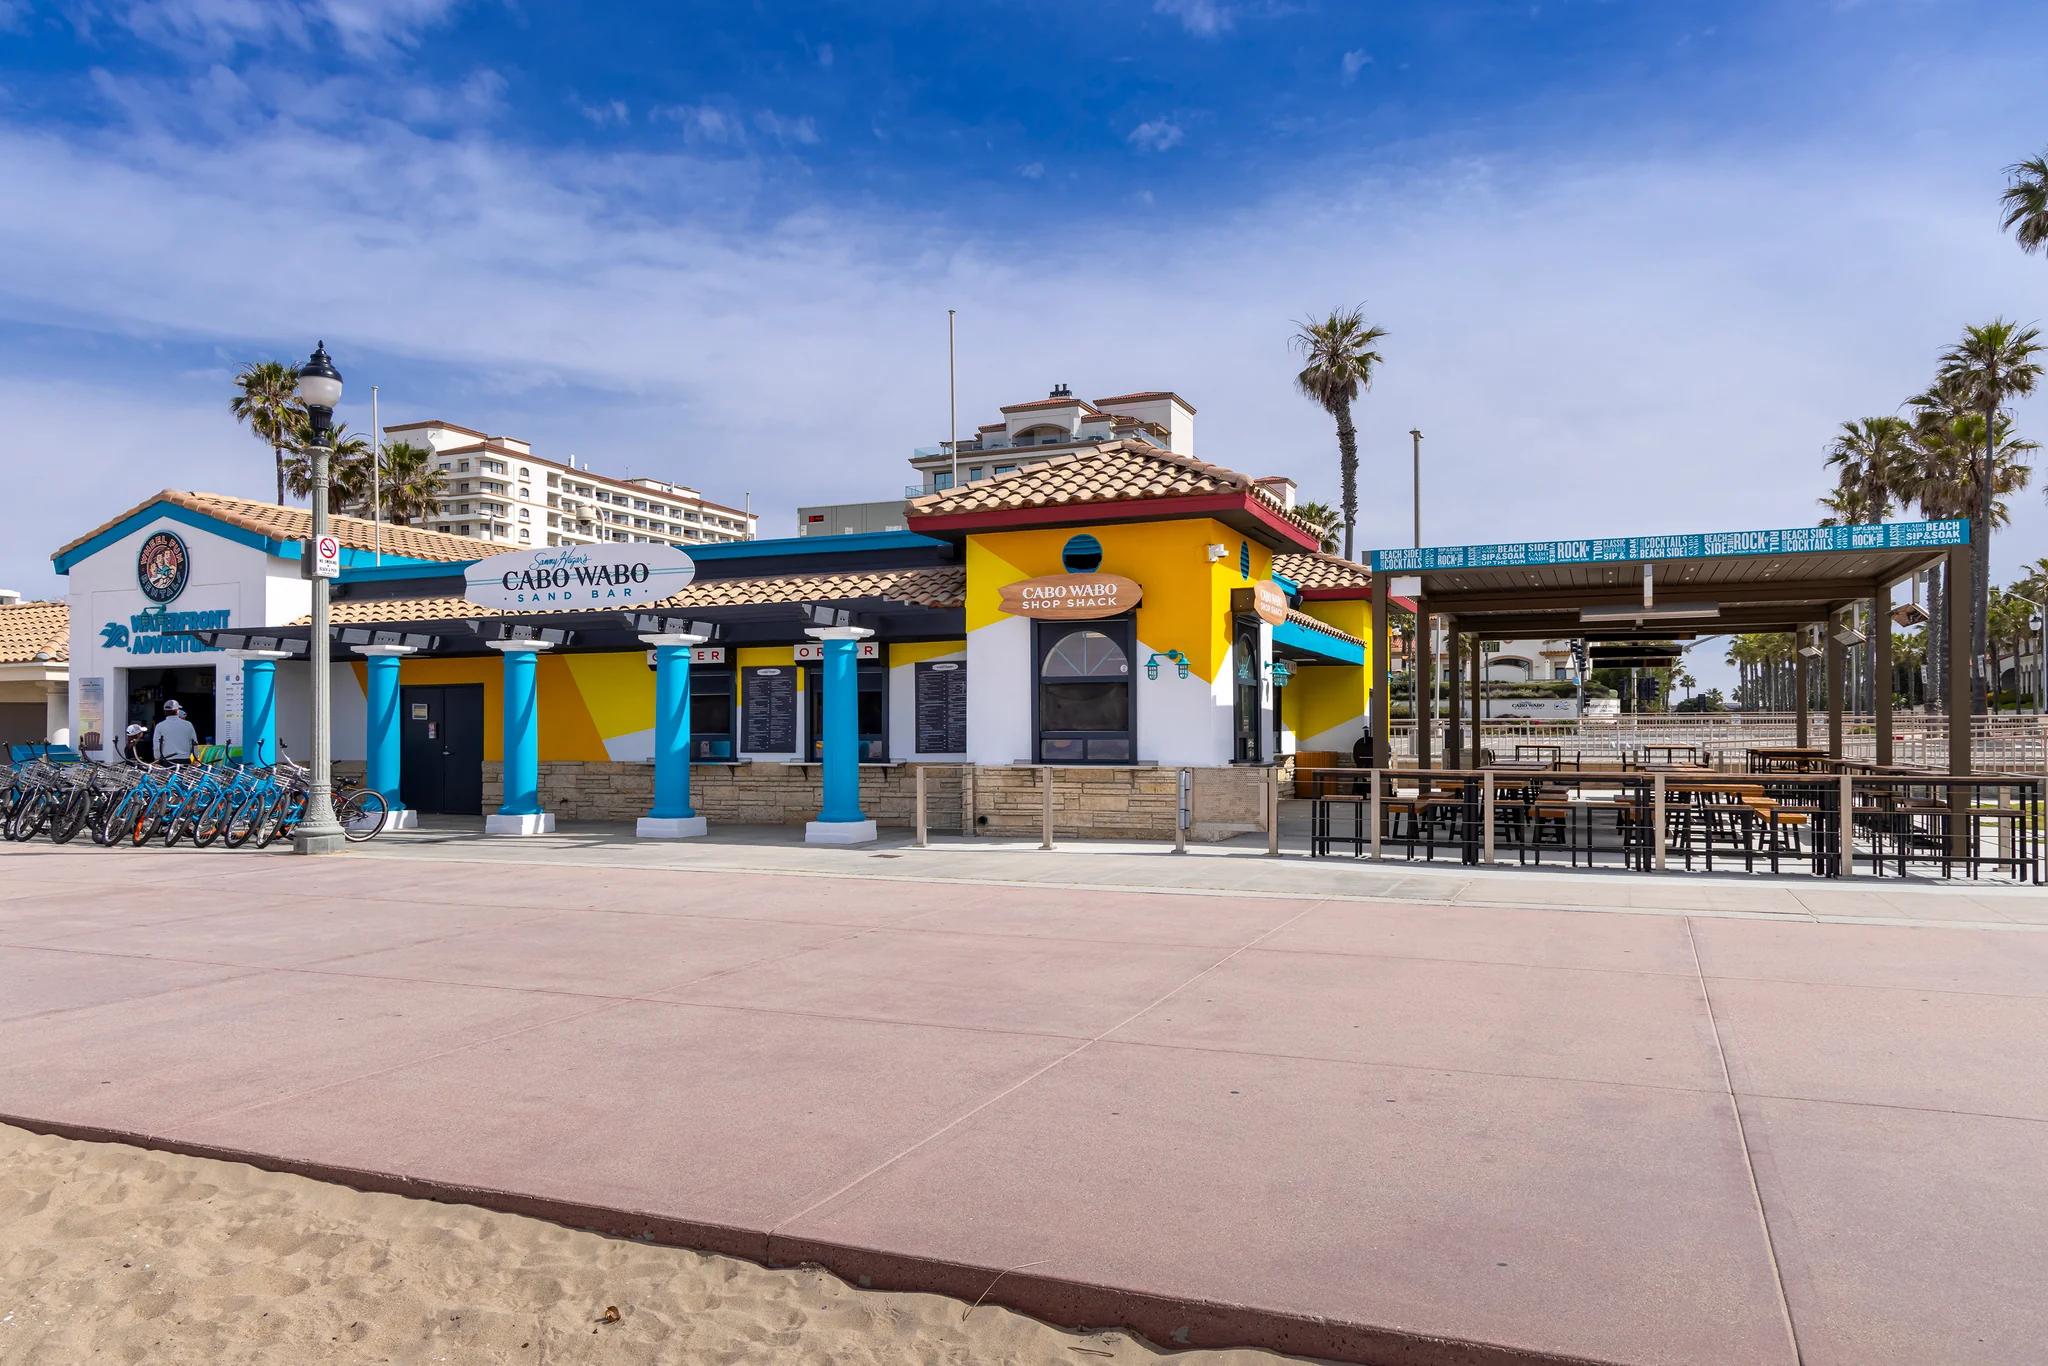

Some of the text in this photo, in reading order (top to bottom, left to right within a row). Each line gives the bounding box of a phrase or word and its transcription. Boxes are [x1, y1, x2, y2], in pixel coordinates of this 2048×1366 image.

[1926, 521, 1960, 532] BEACH
[1704, 533, 1727, 543] BEACH
[1781, 529, 1809, 540] BEACH
[1810, 528, 1829, 539] SIDE
[1852, 534, 1873, 546] ROCK
[1890, 524, 1898, 547] CLASSIC
[1906, 530, 1960, 541] SIP&SOAK
[1603, 539, 1626, 548] CLASSIC
[1644, 535, 1688, 549] COCKTAILS
[1733, 531, 1766, 551] ROCK
[1770, 531, 1779, 552] ROLL
[1787, 539, 1833, 552] COCKTAILS
[141, 535, 184, 565] WHEEL FUN
[1380, 550, 1402, 560] BEACH
[1403, 549, 1420, 559] SIDE
[1498, 543, 1549, 553] BEACH SIDE
[1558, 541, 1587, 559] ROCK
[1593, 540, 1602, 560] ROLL
[1640, 548, 1664, 559] BEACH
[1666, 547, 1684, 557] SIDE
[1704, 542, 1728, 555] SIDE
[529, 547, 591, 570] Sammy Hagar's
[1437, 554, 1456, 566] ROCK
[1481, 551, 1526, 561] SIP&SOAK
[1384, 557, 1422, 570] COCKTAILS
[502, 562, 649, 591] CABO WABO
[141, 571, 182, 599] RENTALS
[1022, 583, 1118, 599] CABO WABO
[517, 588, 632, 603] SAND BAR
[1022, 597, 1117, 610] SHOP SHACK
[130, 609, 231, 633] WATERFRONT
[132, 635, 225, 654] ADVENTU
[799, 645, 873, 657] ORR
